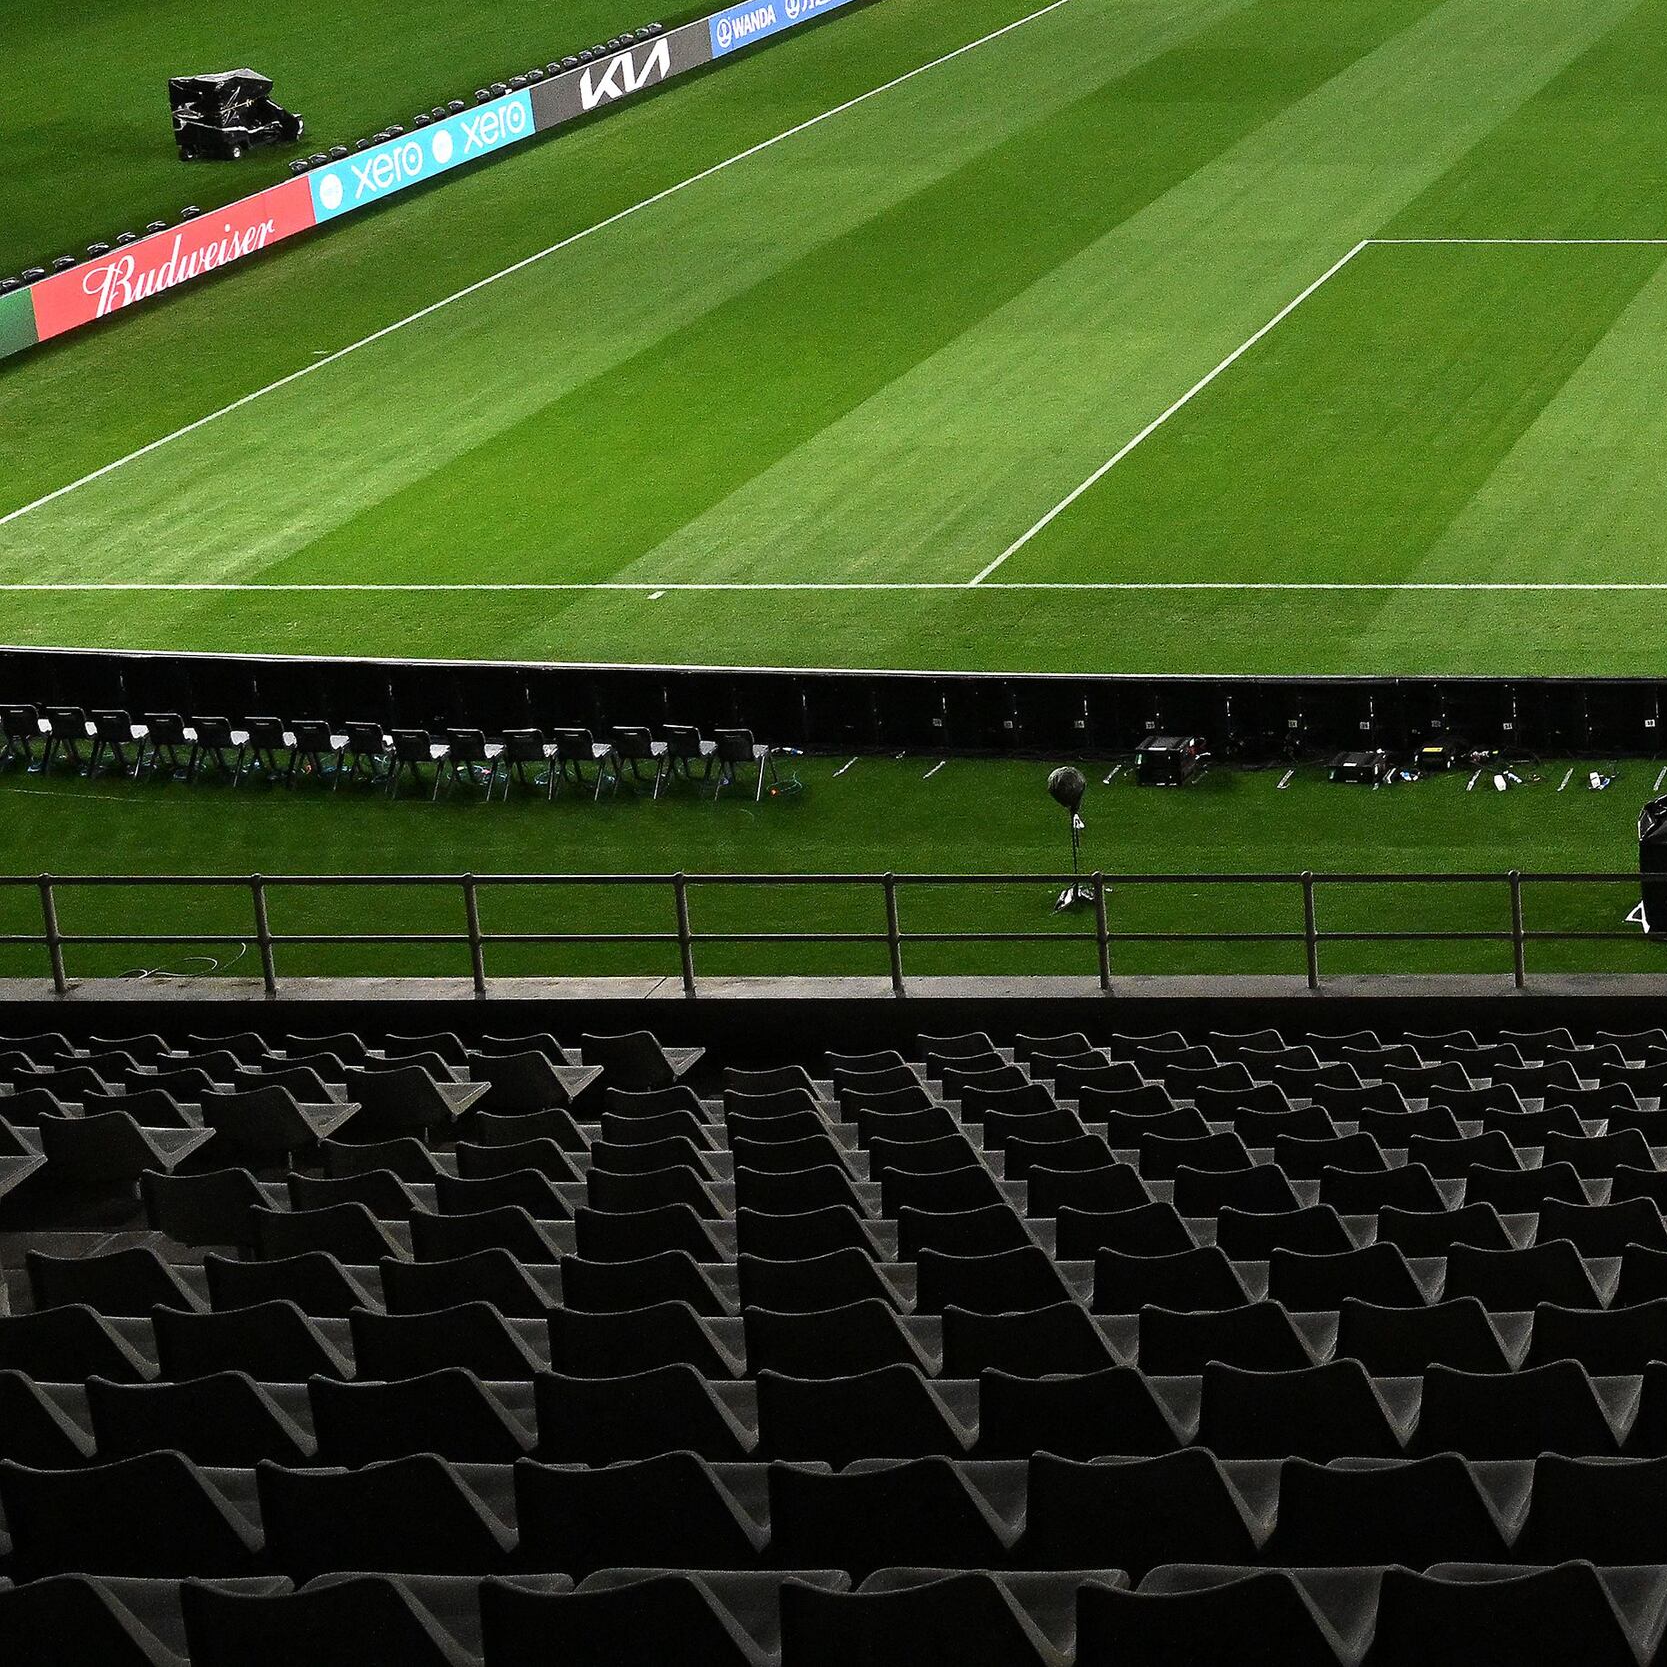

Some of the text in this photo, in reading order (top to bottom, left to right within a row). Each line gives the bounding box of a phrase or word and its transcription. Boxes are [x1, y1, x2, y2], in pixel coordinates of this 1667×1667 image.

[731, 4, 777, 40] WANDA
[461, 99, 527, 154] xero
[351, 140, 423, 200] xero
[82, 217, 275, 319] Budweiser
